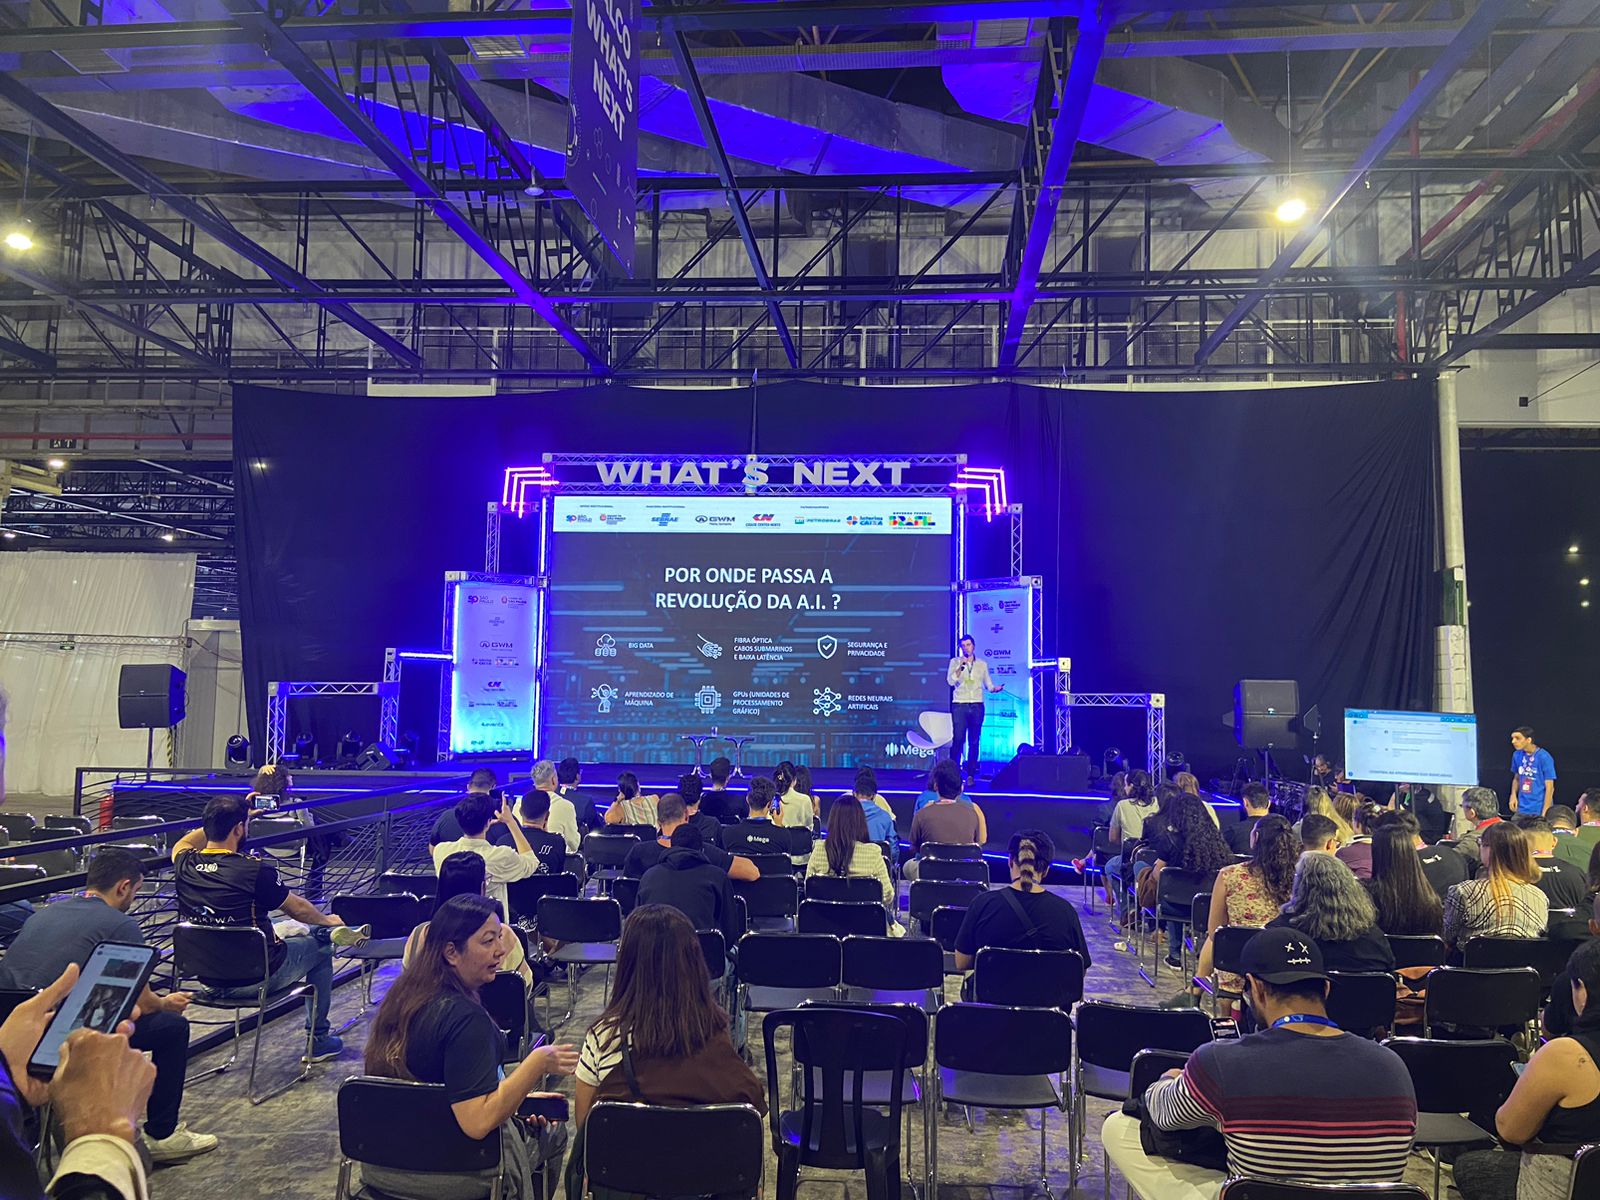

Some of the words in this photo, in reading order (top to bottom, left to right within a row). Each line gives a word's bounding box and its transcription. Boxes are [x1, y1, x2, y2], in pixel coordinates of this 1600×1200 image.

[605, 0, 631, 60] LCO
[586, 0, 633, 113] WHAT'S
[593, 58, 625, 141] NEXT
[596, 459, 769, 486] WHAT'S
[793, 461, 911, 486] NEXT
[889, 516, 936, 526] BRASIL
[664, 567, 701, 583] POR
[705, 567, 756, 583] ONDE
[761, 568, 816, 584] PASSA
[820, 568, 834, 584] A
[655, 590, 762, 613] REVOLUÇÃO
[767, 594, 792, 609] DA
[796, 594, 826, 610] A.I.
[831, 593, 841, 610] ?
[847, 641, 883, 649] SEGURANÇA
[732, 707, 760, 715] GRÁFICO)
[900, 745, 934, 758] Mega
